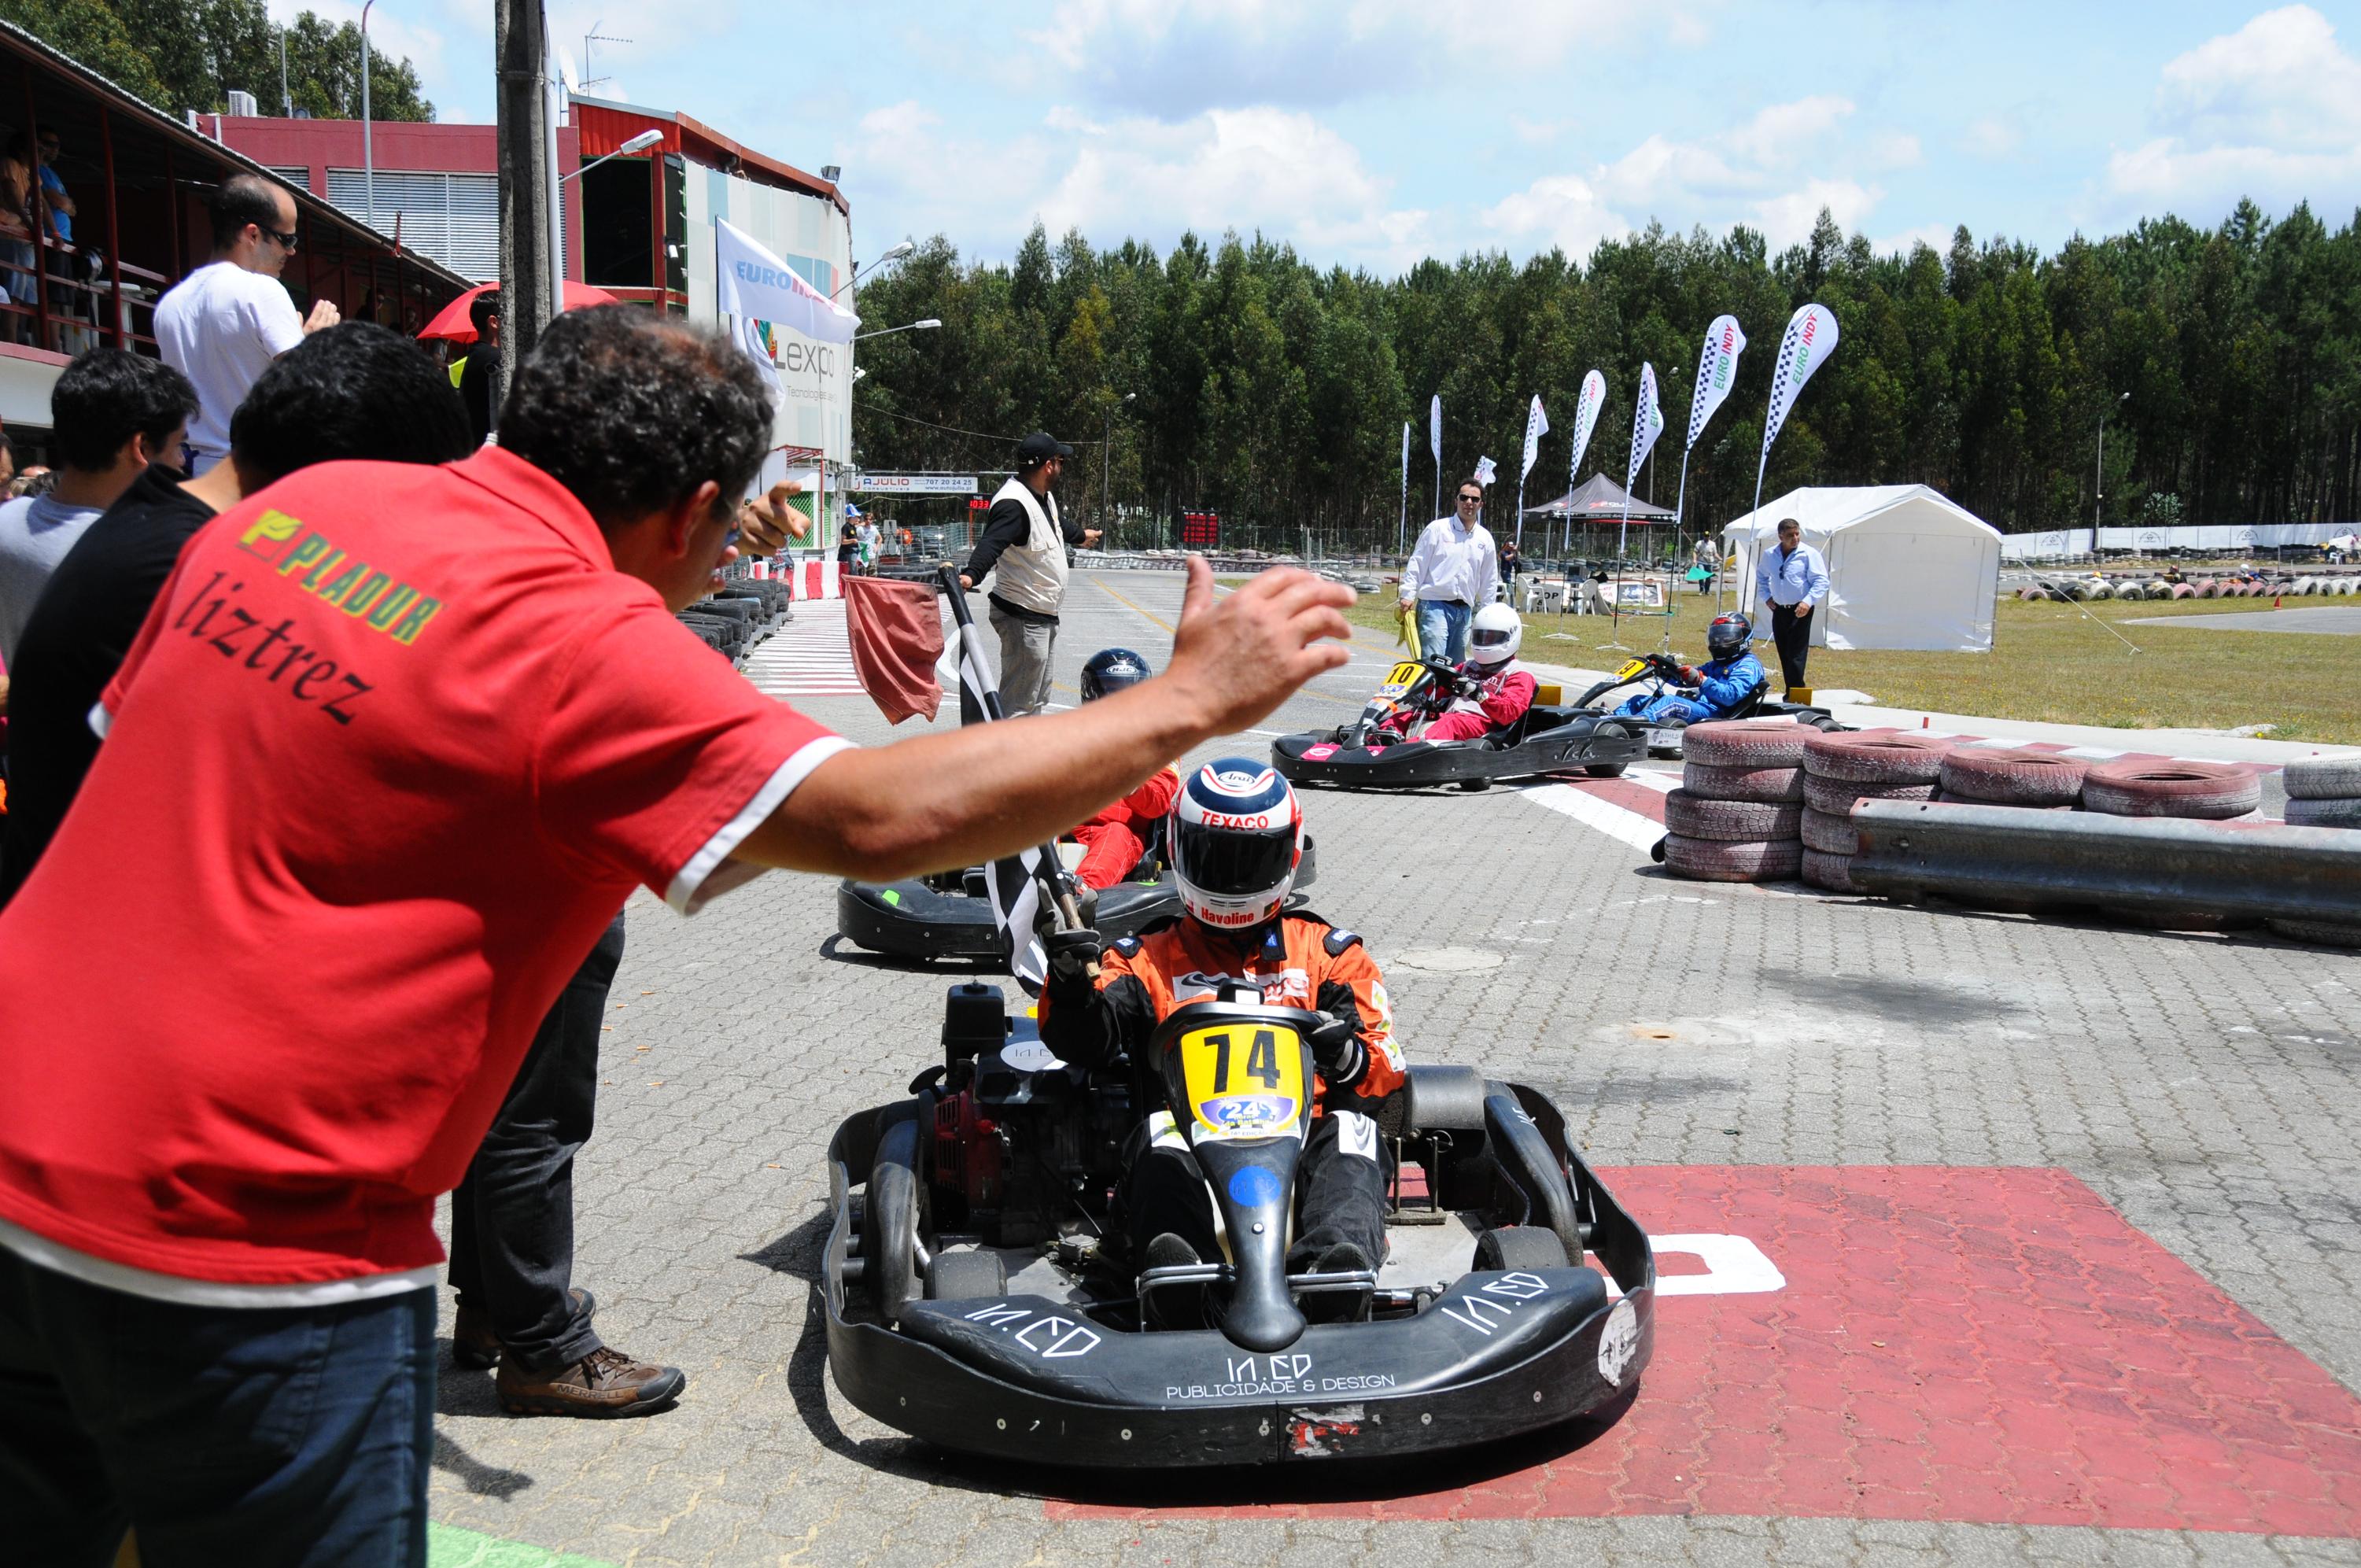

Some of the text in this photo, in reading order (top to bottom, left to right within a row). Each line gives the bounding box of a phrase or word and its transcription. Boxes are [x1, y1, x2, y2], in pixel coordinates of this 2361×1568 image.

[736, 260, 792, 290] EURO
[1714, 323, 1735, 390] EURO INDY
[1792, 313, 1817, 385] EURO INDY
[1584, 402, 1592, 431] EURO
[276, 532, 442, 646] PLADUR
[1387, 666, 1415, 684] 10
[1201, 810, 1268, 831] TEXACO
[1201, 906, 1254, 925] Havoline
[1204, 1030, 1280, 1094] 74
[1226, 1101, 1260, 1120] 24
[1166, 1374, 1396, 1400] PUBLICIDADE & DESIGN
